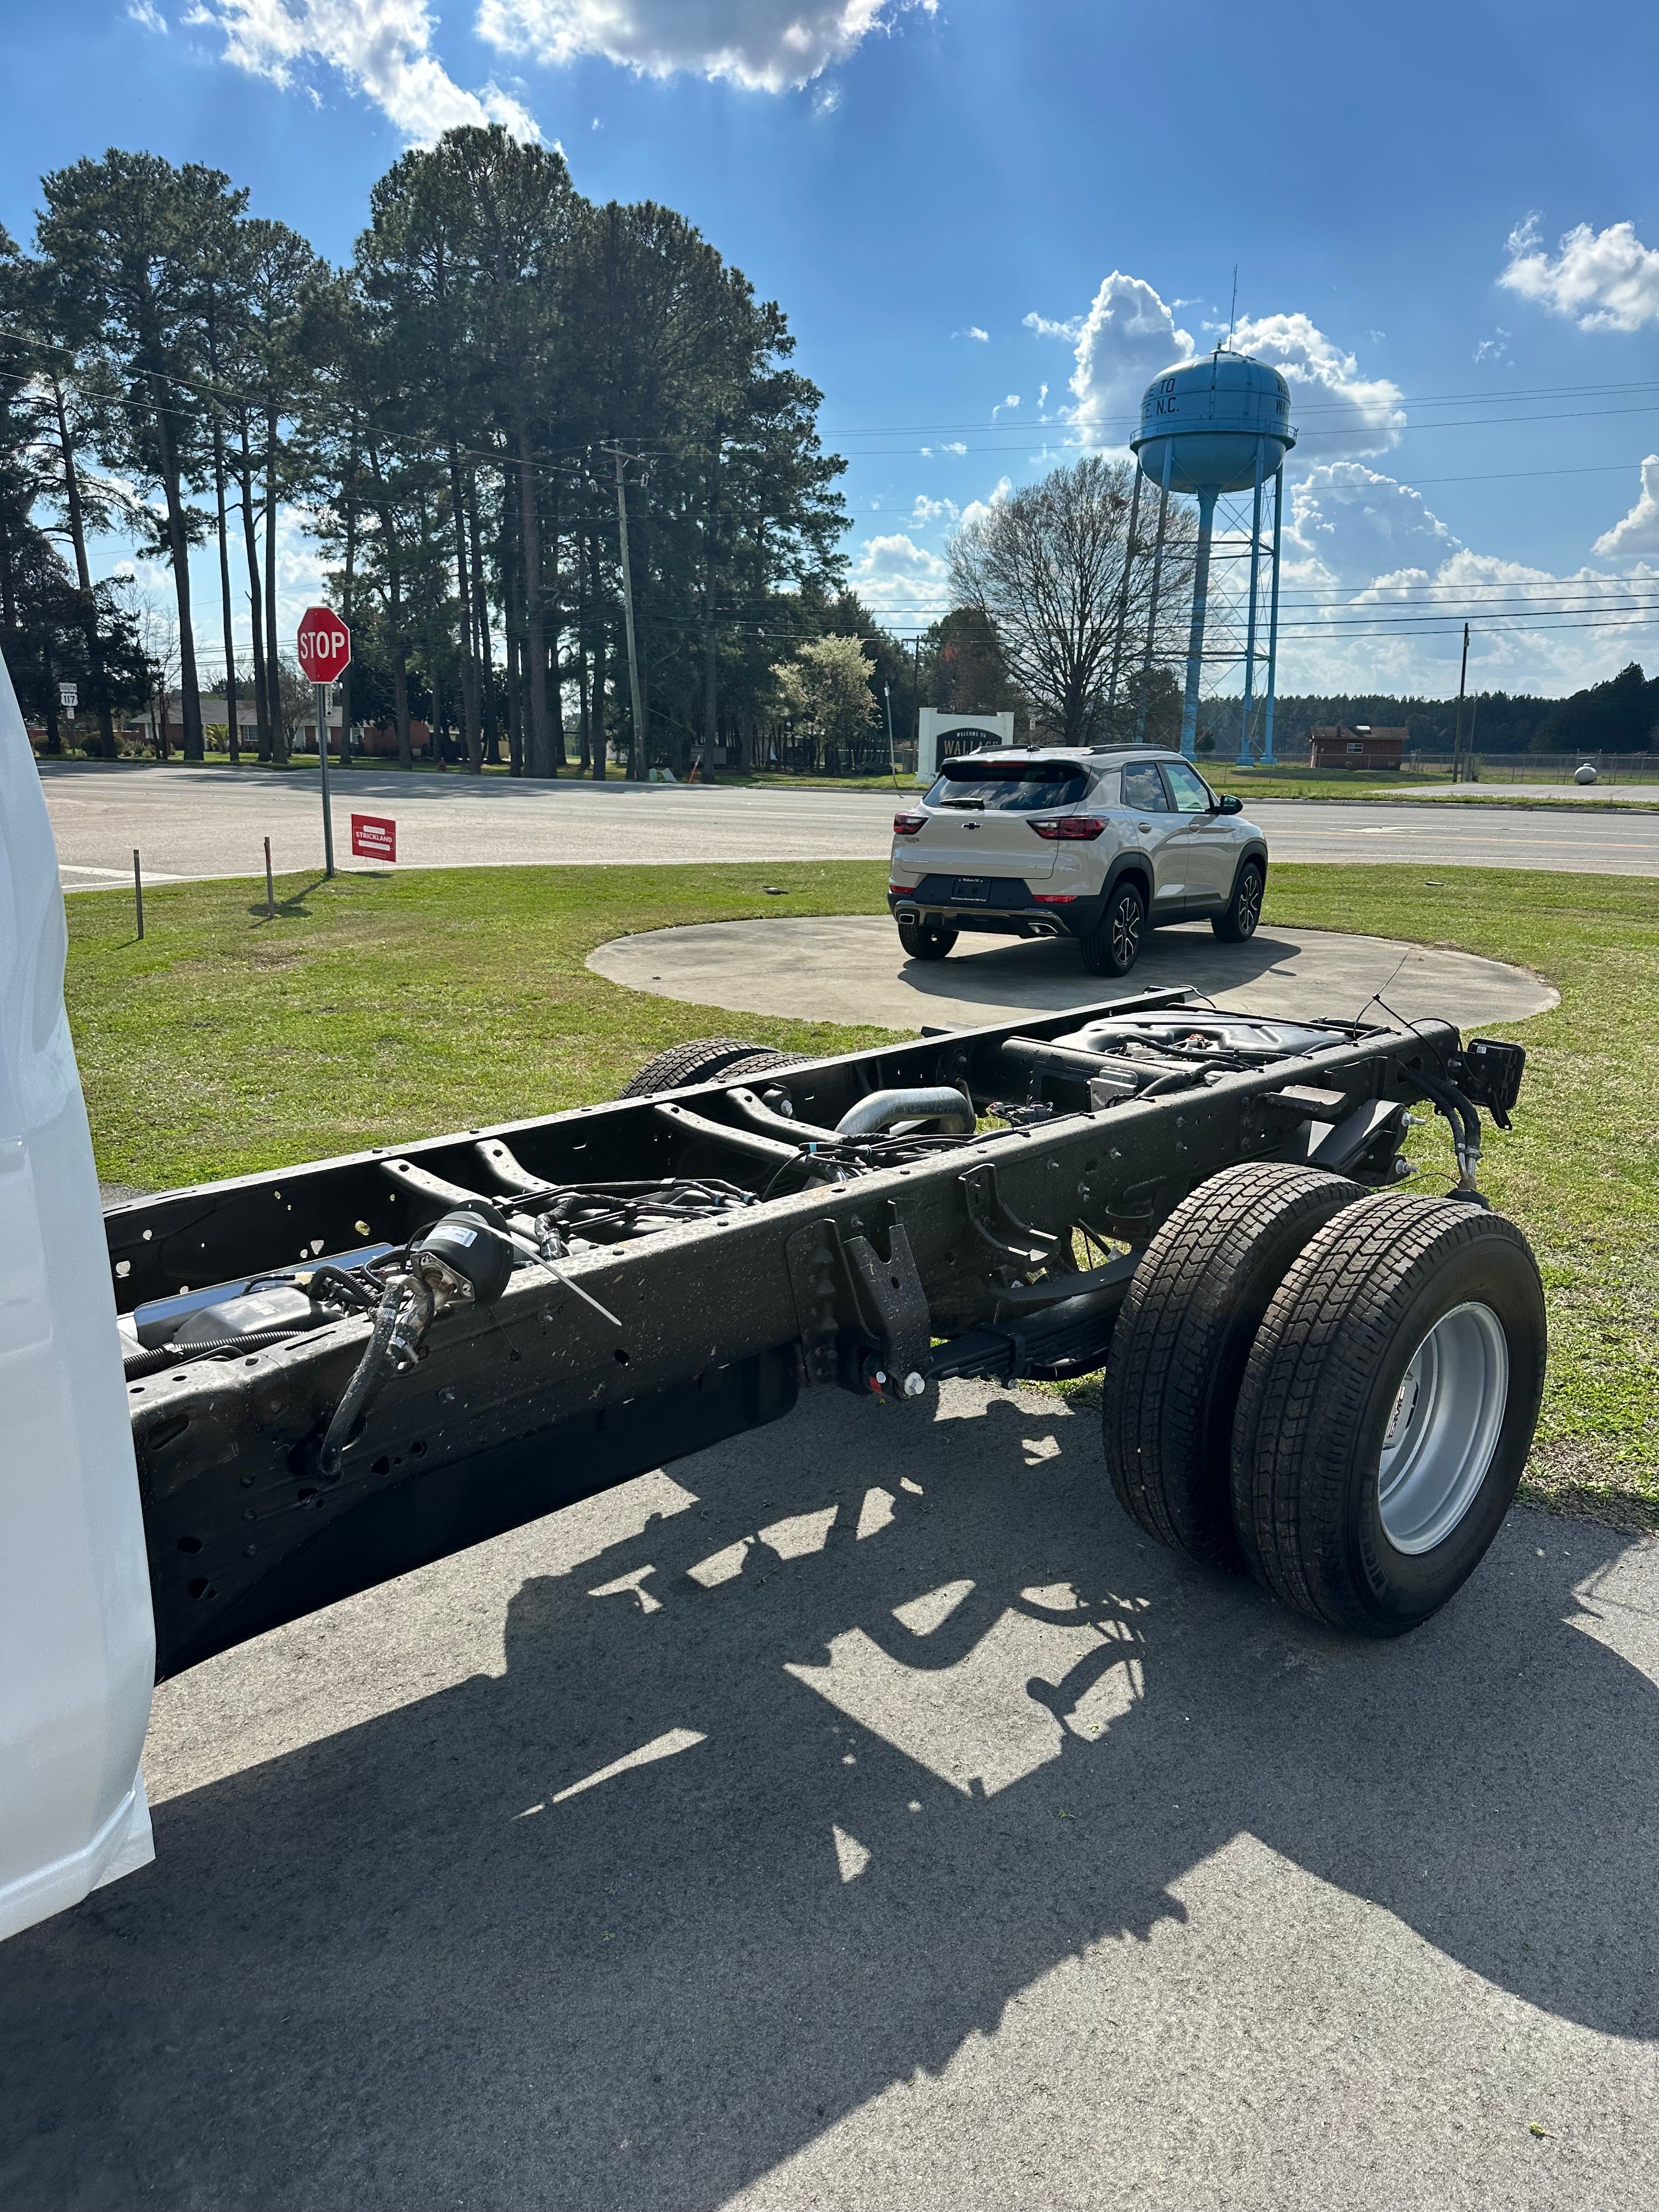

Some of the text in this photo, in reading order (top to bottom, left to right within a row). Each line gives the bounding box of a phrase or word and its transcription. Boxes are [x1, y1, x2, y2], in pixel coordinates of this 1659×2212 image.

[1160, 378, 1176, 394] TO
[1156, 396, 1180, 416] N.C.
[300, 631, 345, 659] STOP
[64, 695, 75, 704] 117
[356, 831, 392, 843] STRICKLAND
[1387, 1385, 1406, 1438] GMC
